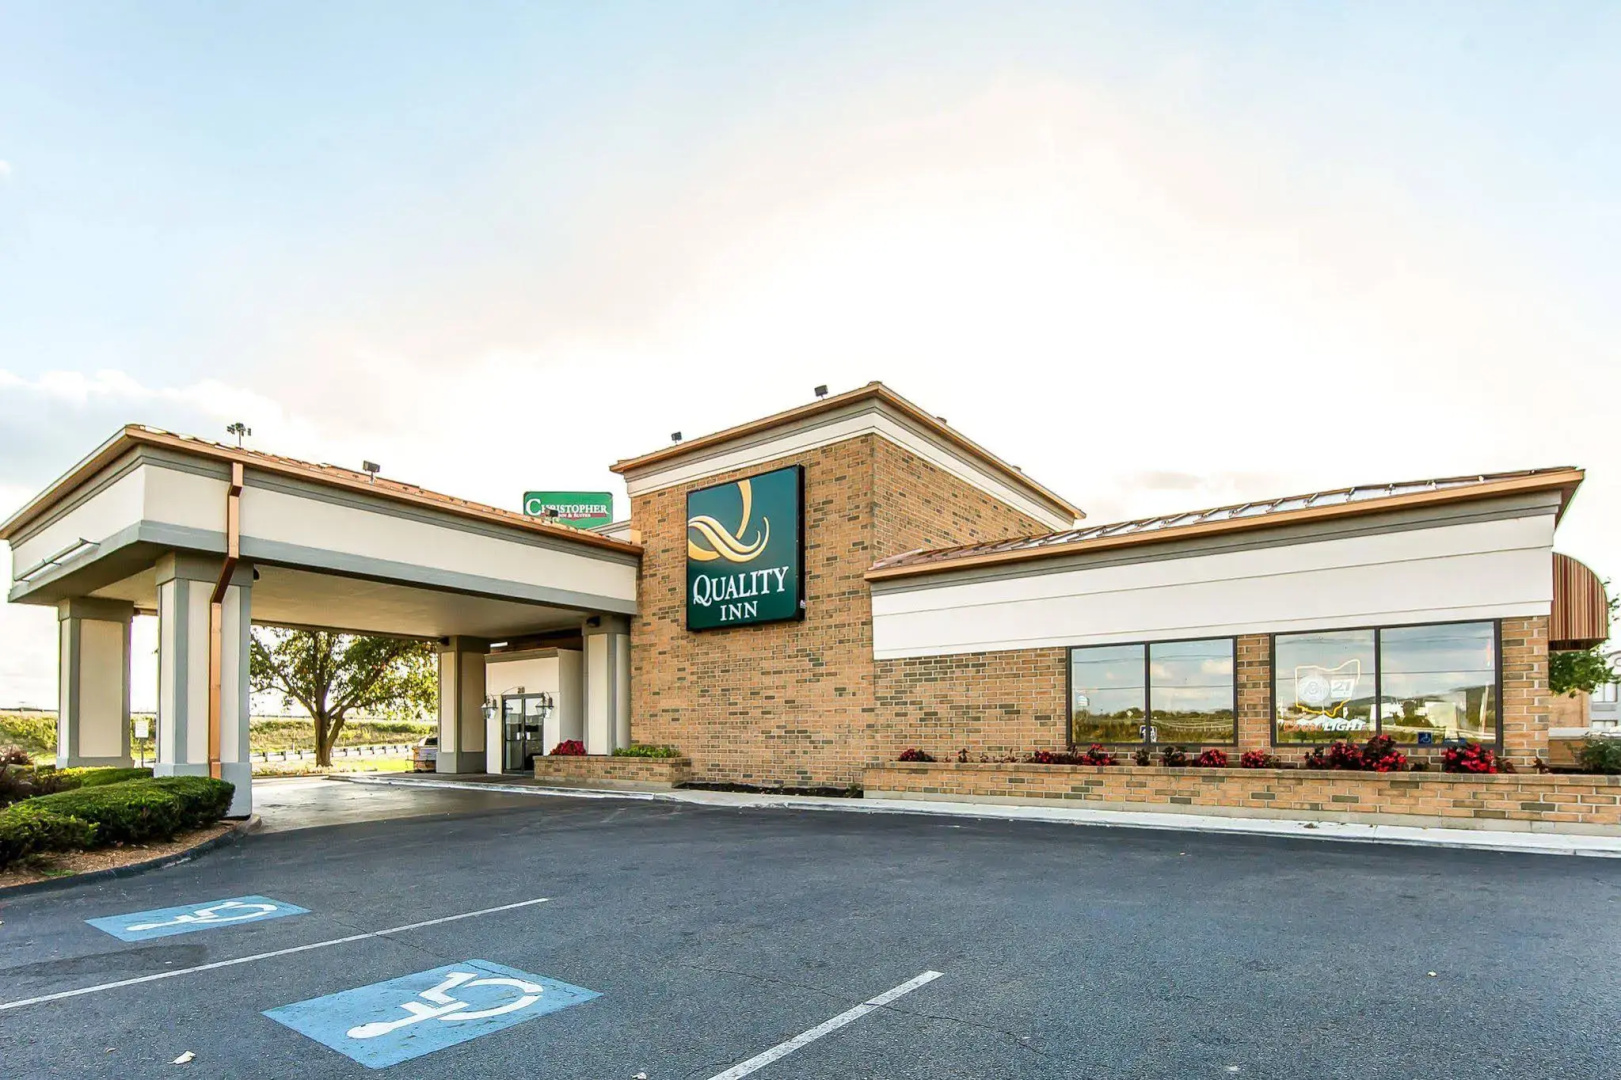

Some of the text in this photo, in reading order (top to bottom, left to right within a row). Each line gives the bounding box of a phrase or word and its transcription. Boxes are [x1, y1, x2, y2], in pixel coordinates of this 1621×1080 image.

[693, 566, 789, 607] QUALITY
[720, 600, 758, 621] INN
[1323, 721, 1366, 732] LIGHT
